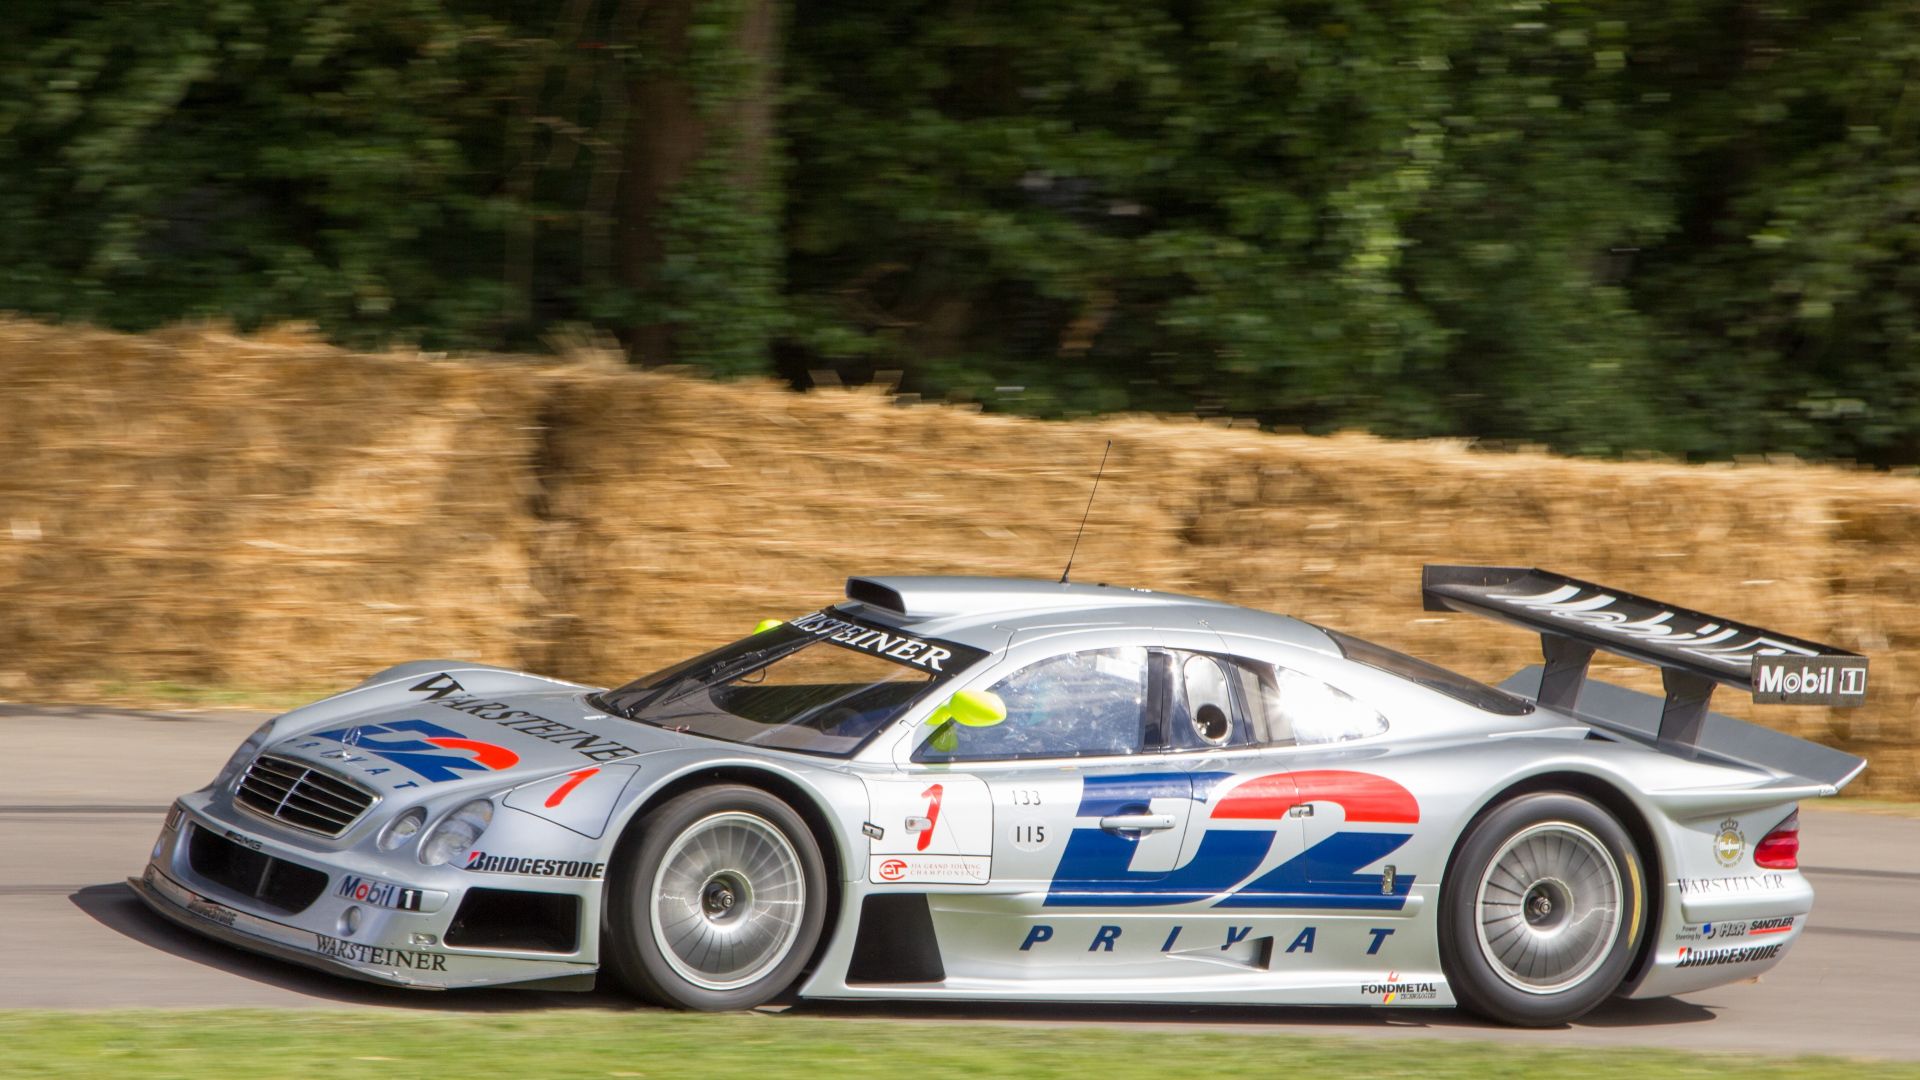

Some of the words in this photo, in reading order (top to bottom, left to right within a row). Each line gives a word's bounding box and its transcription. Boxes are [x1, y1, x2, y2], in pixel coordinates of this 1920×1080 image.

[1758, 666, 1834, 695] Mobil
[310, 719, 520, 783] D2
[544, 768, 601, 808] 1
[1011, 790, 1042, 806] 133
[917, 783, 944, 851] 1
[1016, 826, 1046, 843] 115
[1042, 769, 1421, 911] D2
[464, 851, 605, 879] BRIDGESTONE
[339, 875, 395, 908] Mobil
[1677, 874, 1785, 894] WARSTEINER
[1749, 917, 1795, 930] SANDTLER
[315, 934, 448, 972] WARSTEINER
[1019, 924, 1396, 955] PRIVAT
[1675, 944, 1784, 969] BRIDGESTONE
[1360, 983, 1437, 994] FONDMETAL
